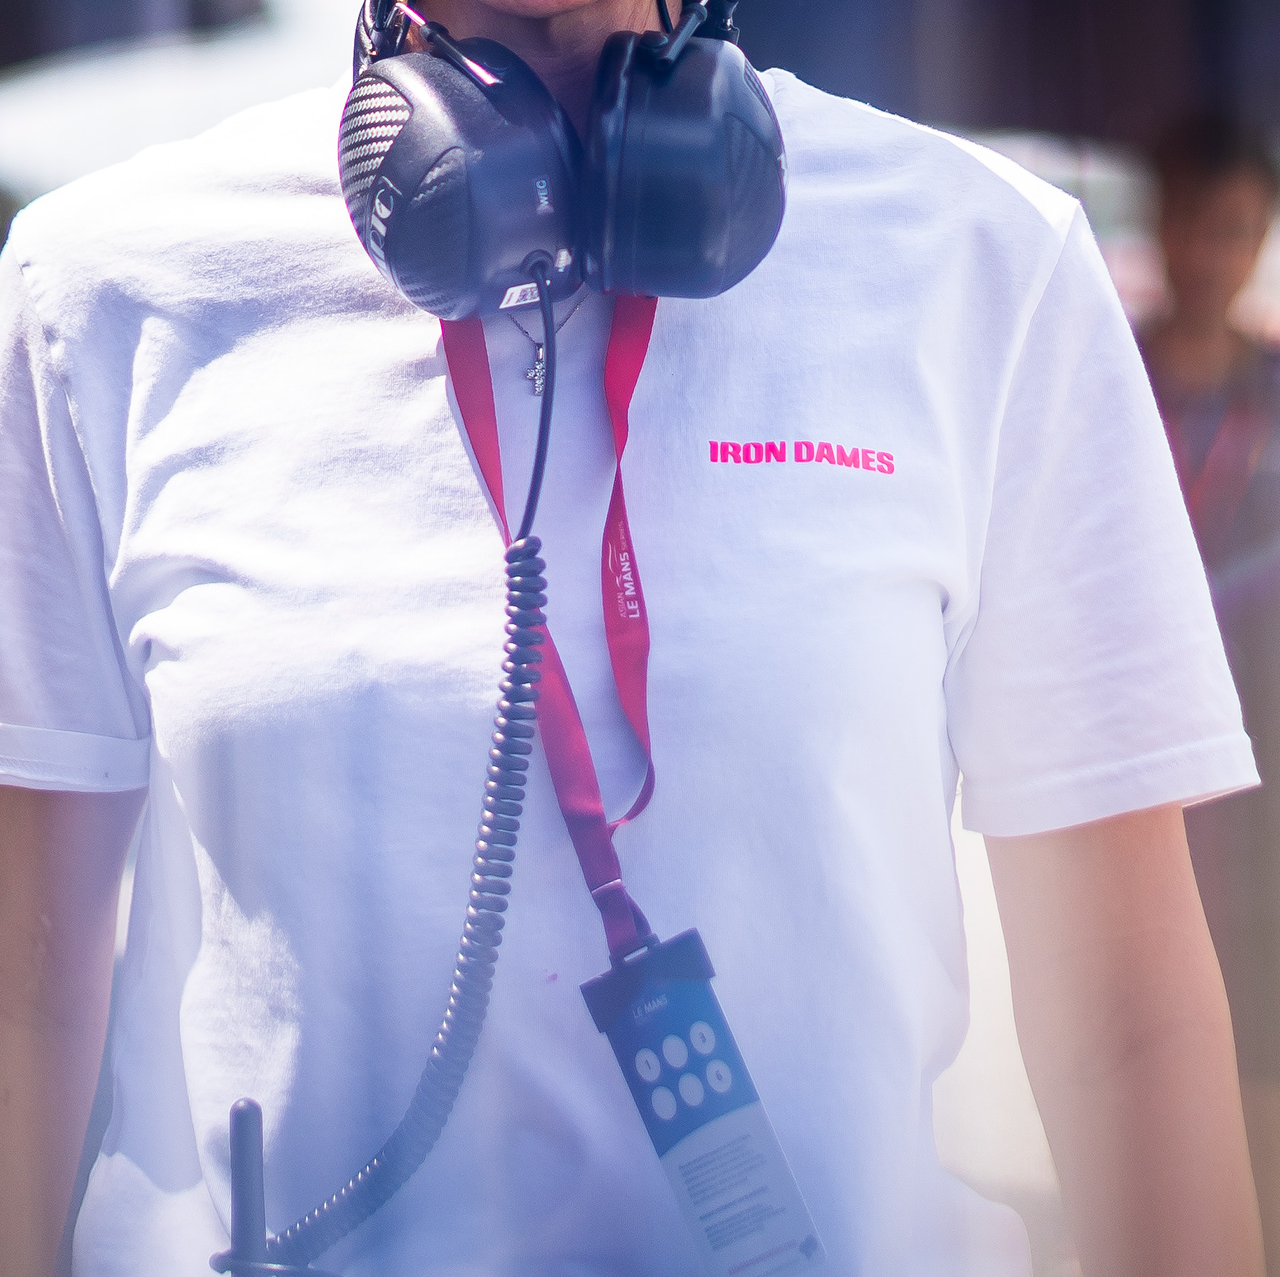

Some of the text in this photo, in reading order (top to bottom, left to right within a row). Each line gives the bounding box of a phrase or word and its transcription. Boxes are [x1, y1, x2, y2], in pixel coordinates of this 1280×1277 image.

[709, 440, 895, 475] IRON DAMES
[619, 551, 640, 619] LE MANS
